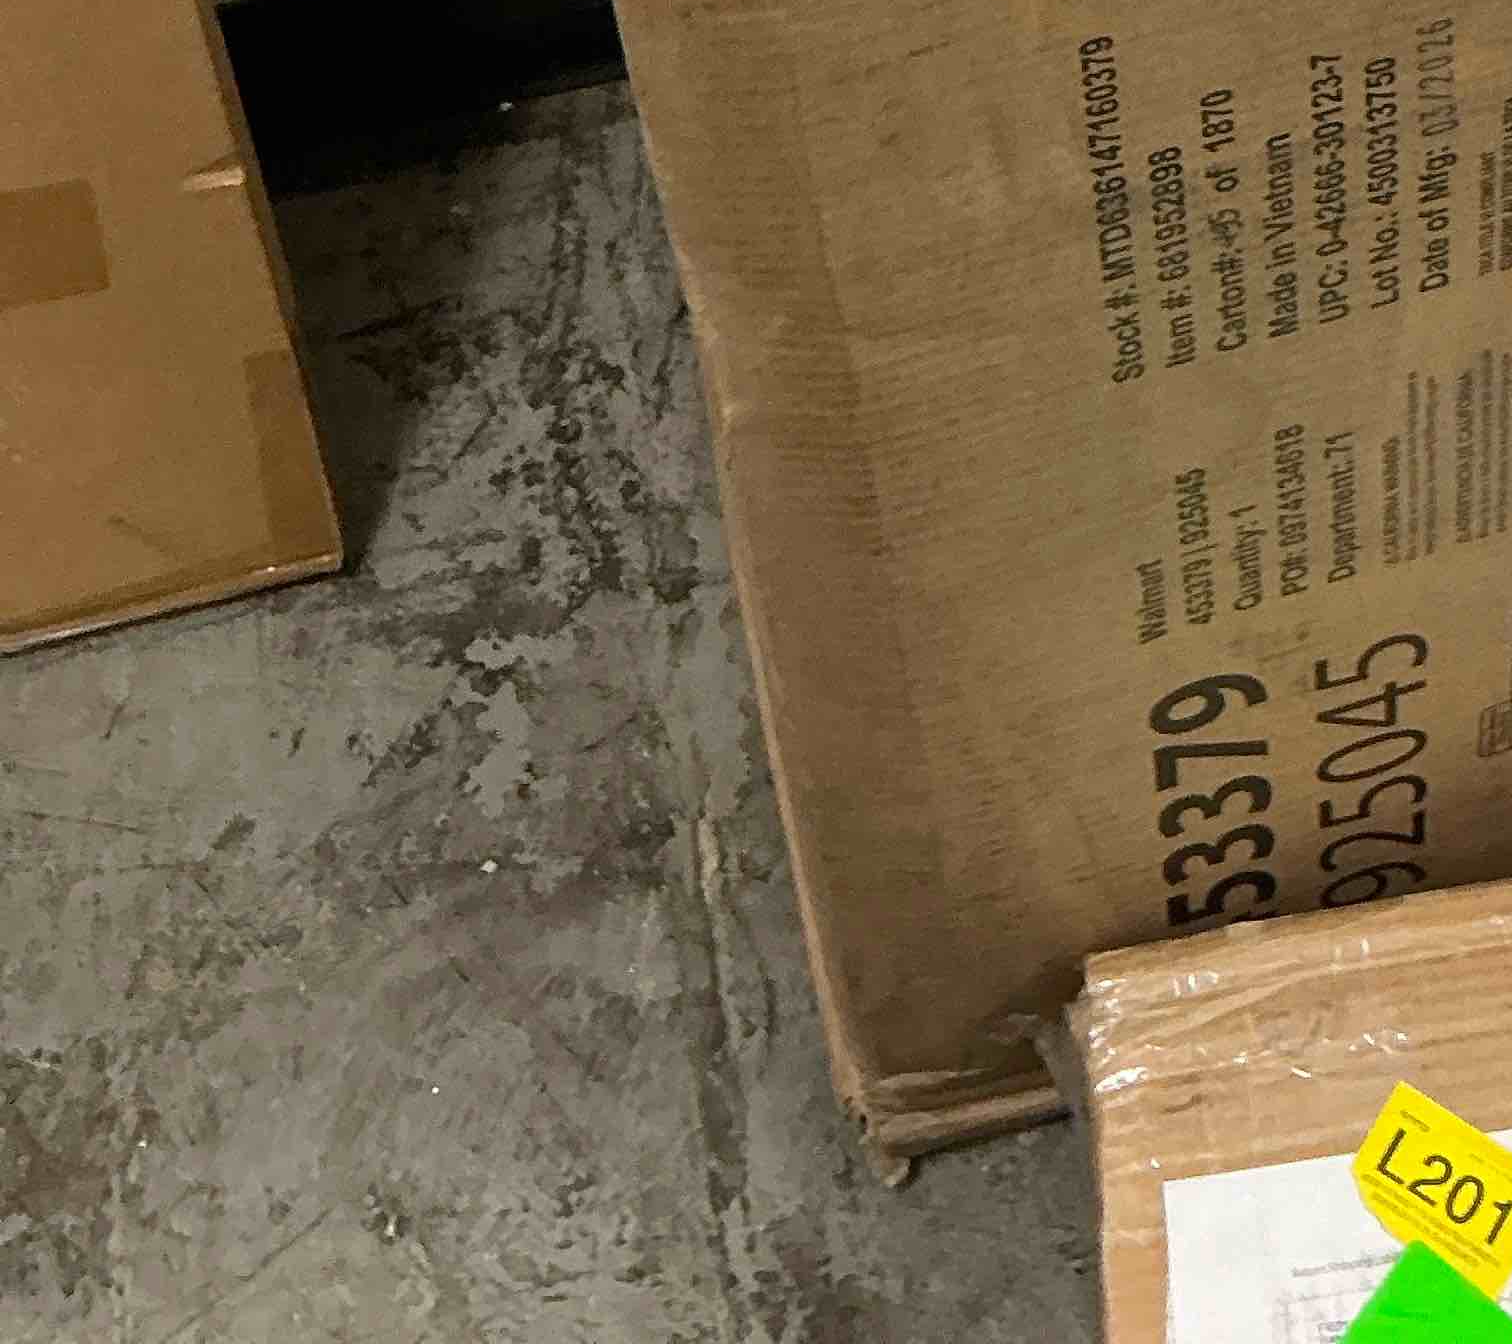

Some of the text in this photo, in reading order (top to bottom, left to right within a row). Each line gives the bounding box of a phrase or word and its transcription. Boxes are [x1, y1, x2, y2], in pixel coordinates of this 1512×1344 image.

[1078, 34, 1136, 283] MTD636147160379
[1199, 87, 1237, 152] 1870
[1364, 54, 1398, 205] 4500313750
[1147, 144, 1190, 282] 681952898
[1204, 165, 1240, 192] of
[1308, 53, 1350, 323] UPC: 0-42666-30123-7
[1417, 144, 1458, 204] Mfg:
[1261, 130, 1301, 337] Made in Vietnam
[1417, 207, 1449, 231] of
[1368, 264, 1400, 309] Lot
[1418, 236, 1450, 291] Date
[1107, 310, 1145, 382] Stock
[1163, 312, 1196, 367] Item
[1174, 467, 1211, 543] 925045
[1322, 430, 1362, 583] Department: 71
[1227, 503, 1268, 610] Quantity: 1
[1134, 557, 1168, 644] Walmart
[1148, 671, 1276, 926] 53379
[1312, 632, 1428, 909] 925045
